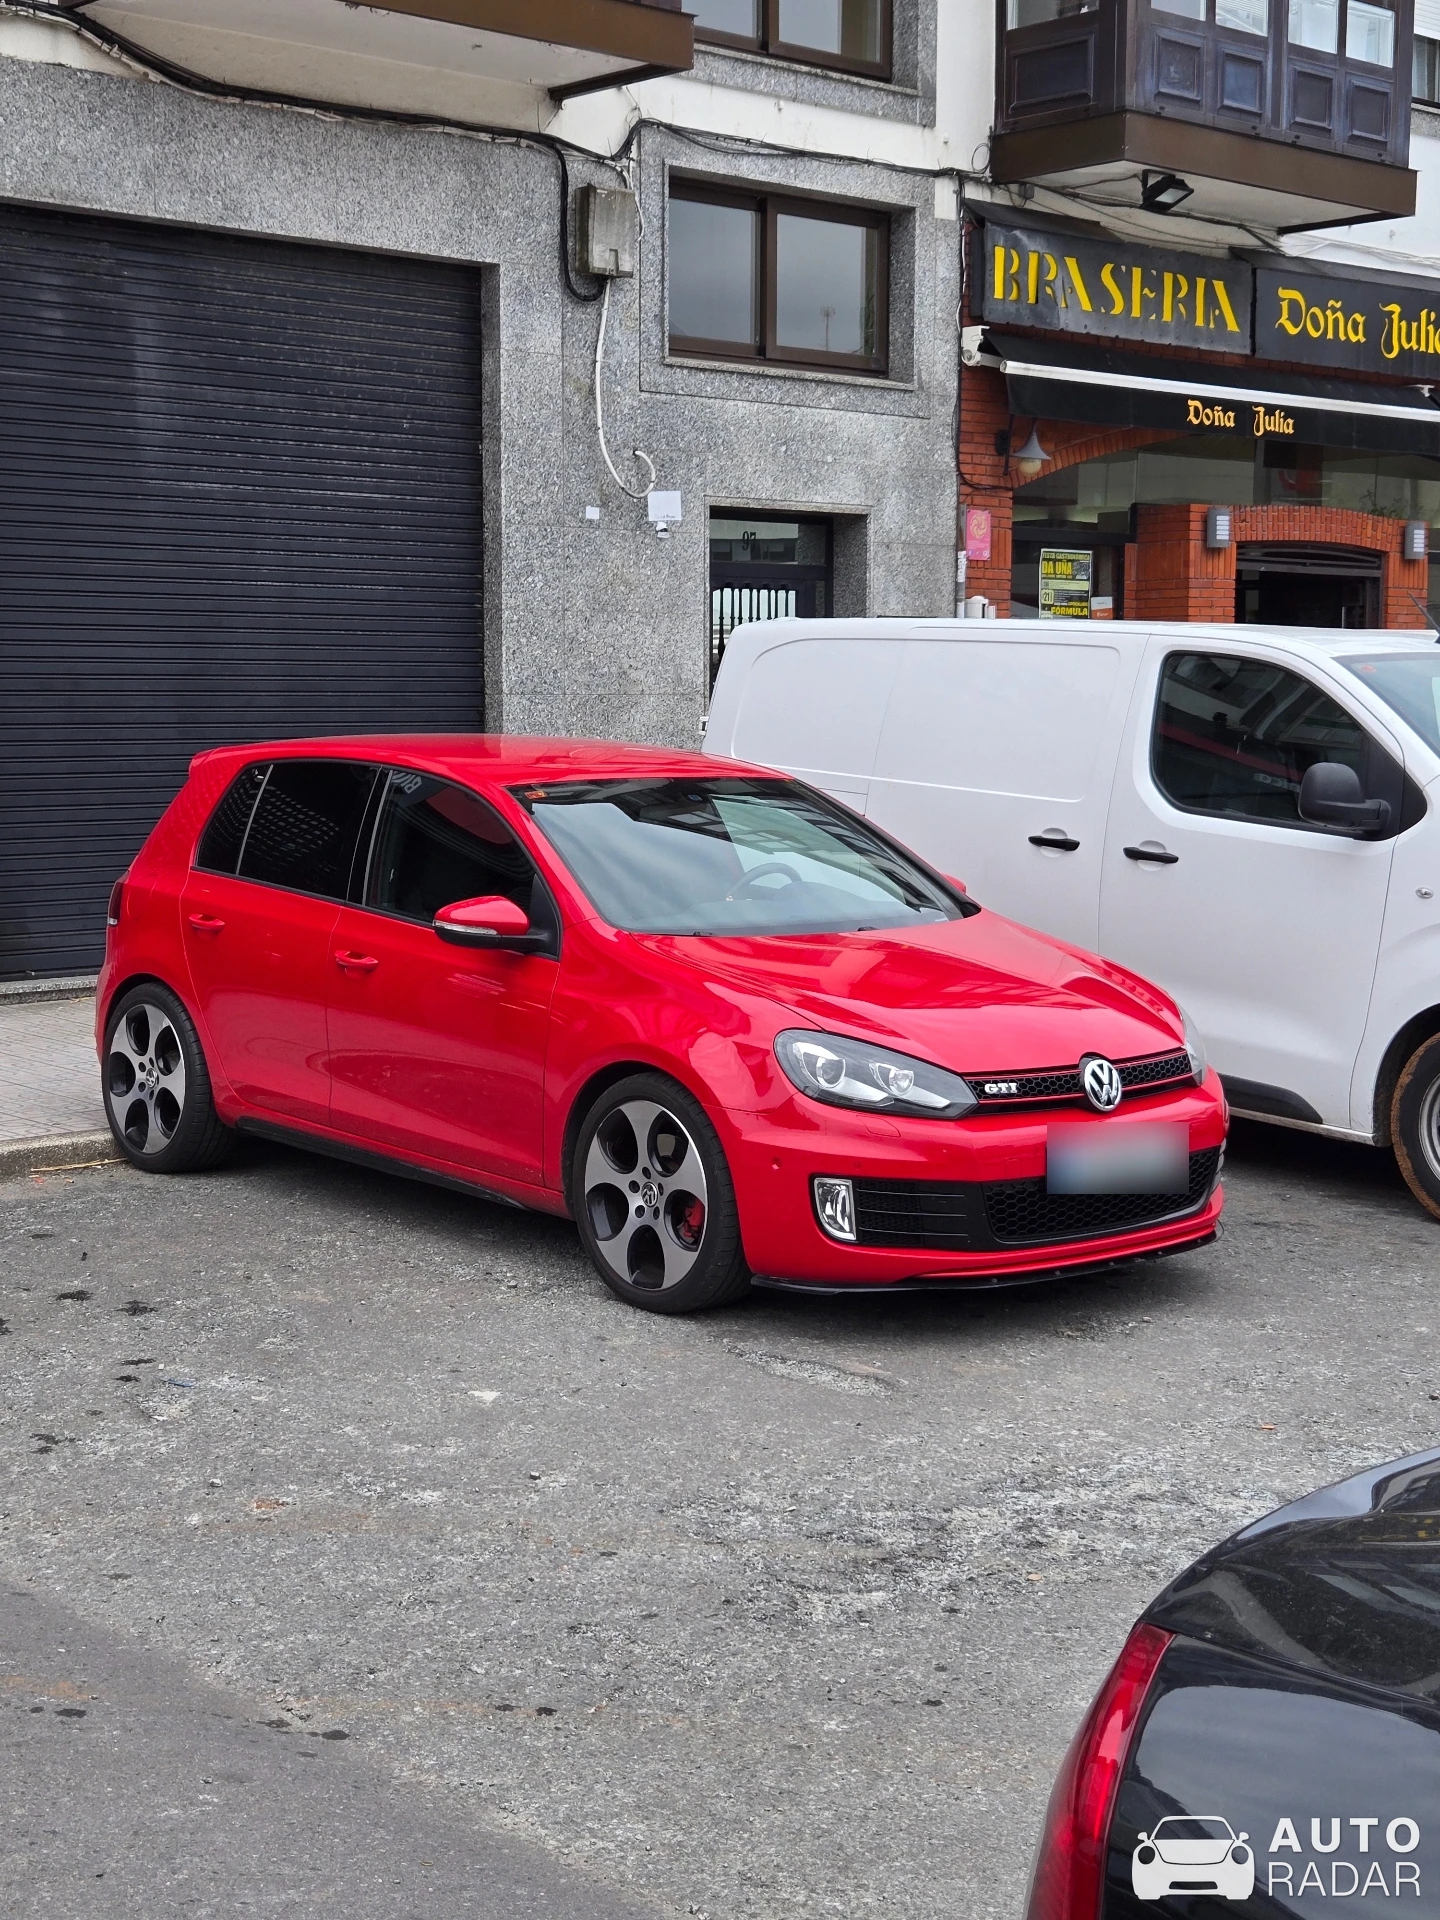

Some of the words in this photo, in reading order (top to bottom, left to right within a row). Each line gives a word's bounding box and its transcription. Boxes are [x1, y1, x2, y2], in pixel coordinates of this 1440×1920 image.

[993, 245, 1241, 333] BRASERIA
[1275, 286, 1367, 344] Doña
[1186, 399, 1236, 428] Doña
[1251, 405, 1295, 437] Julia
[741, 530, 757, 552] 97
[1042, 561, 1054, 574] DA
[1055, 559, 1072, 575] UÑA
[1050, 604, 1088, 616] FÓRMULA
[984, 1082, 1018, 1095] GTI
